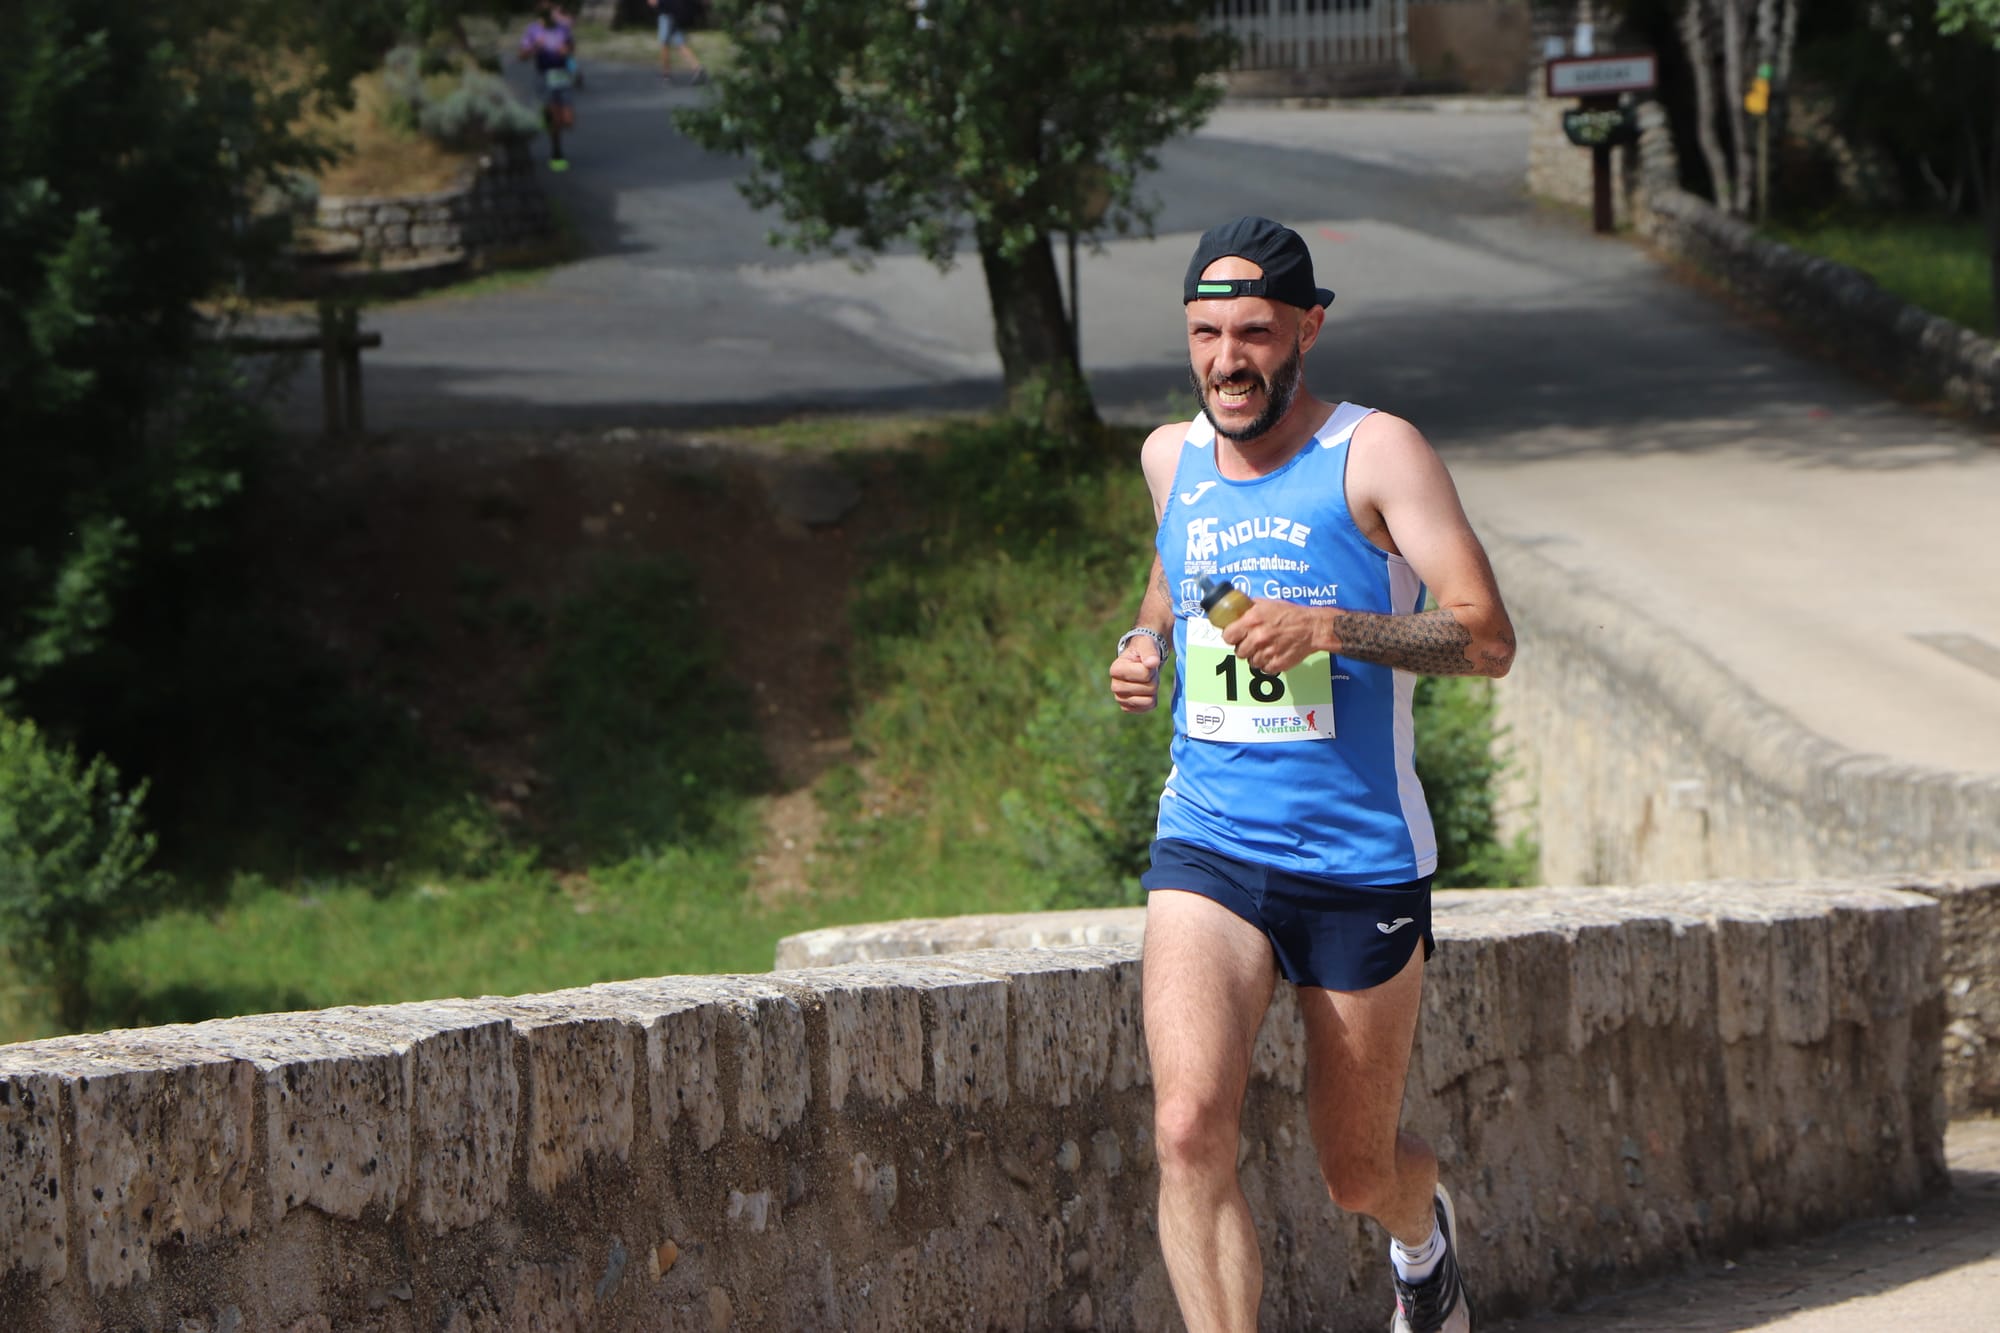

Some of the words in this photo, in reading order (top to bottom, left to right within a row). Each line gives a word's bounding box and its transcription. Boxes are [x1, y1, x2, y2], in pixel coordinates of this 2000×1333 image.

[1215, 654, 1285, 703] 18
[1196, 714, 1221, 725] BFP
[1252, 716, 1301, 727] TUFF'S
[1257, 724, 1307, 734] Aventure
